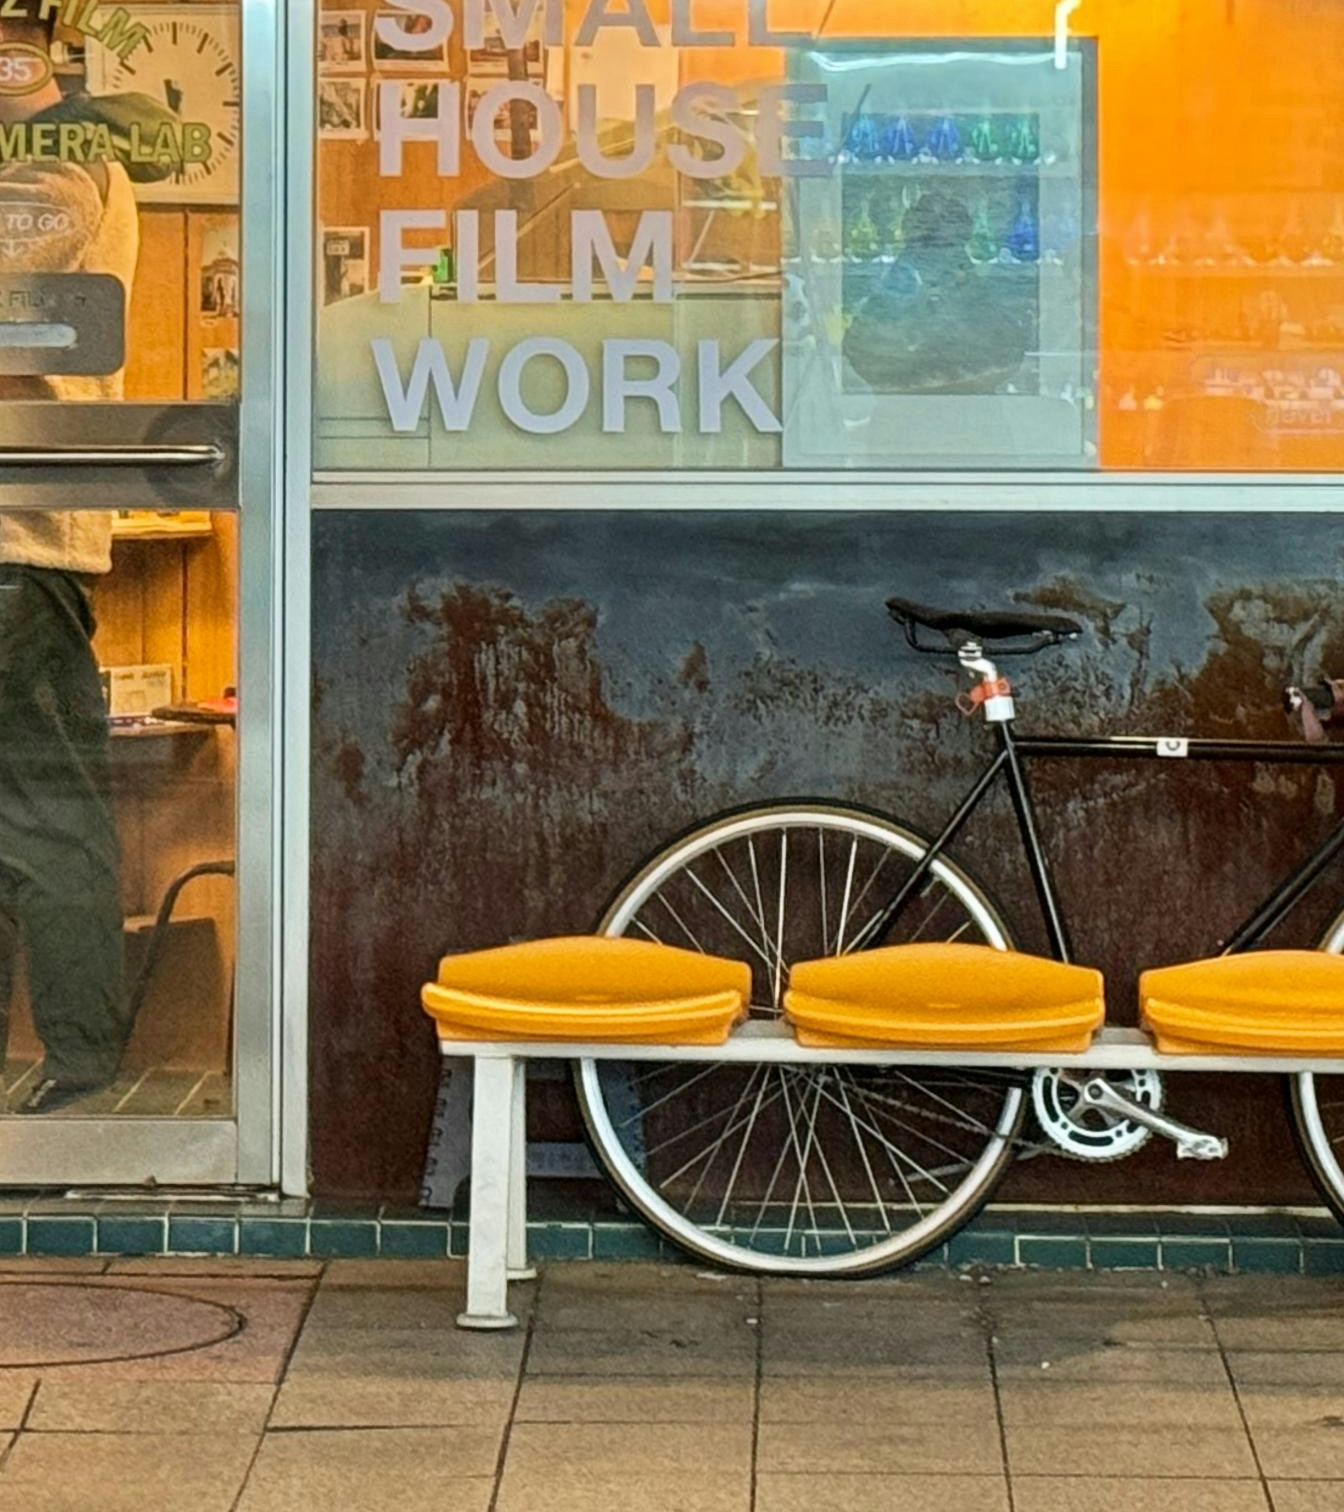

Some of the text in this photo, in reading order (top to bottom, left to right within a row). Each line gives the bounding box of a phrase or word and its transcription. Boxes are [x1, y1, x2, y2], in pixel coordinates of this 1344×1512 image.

[130, 122, 212, 163] LAB
[378, 80, 834, 180] HOUSE
[2, 211, 32, 232] TO
[36, 211, 70, 232] GO
[378, 209, 675, 305] FILM
[370, 336, 784, 434] WORK
